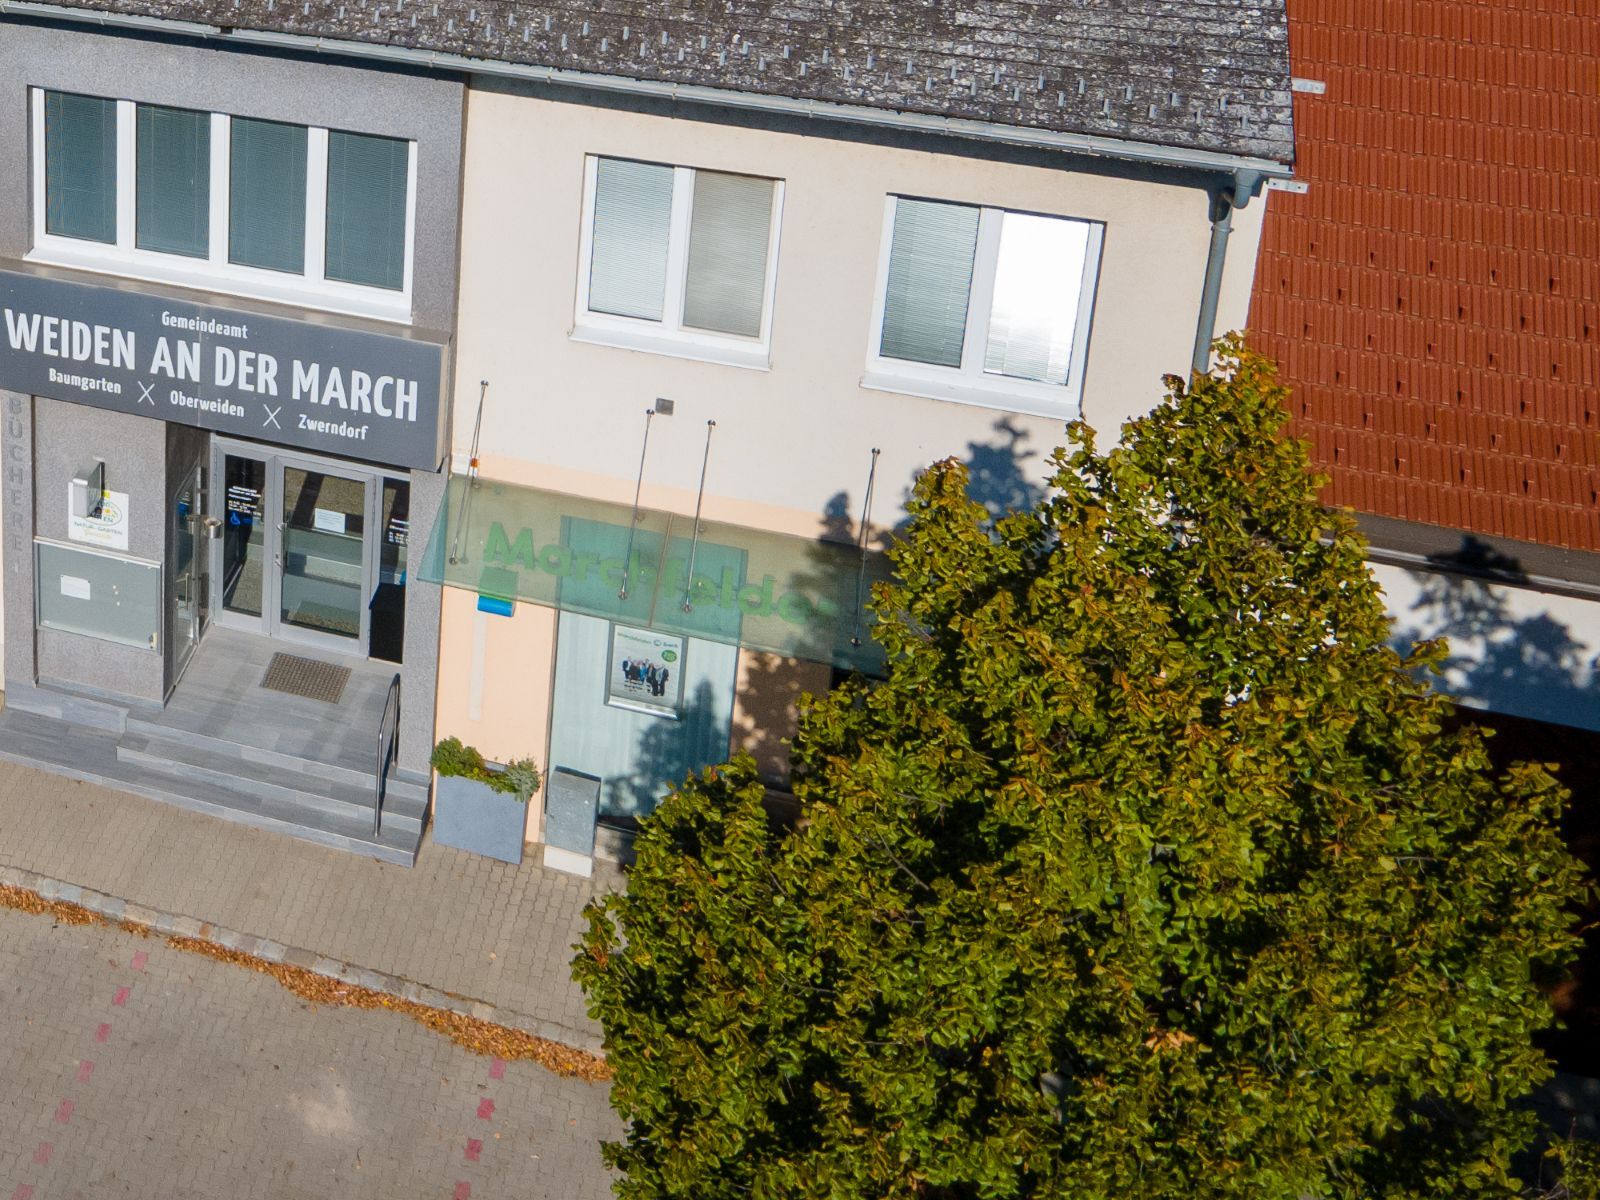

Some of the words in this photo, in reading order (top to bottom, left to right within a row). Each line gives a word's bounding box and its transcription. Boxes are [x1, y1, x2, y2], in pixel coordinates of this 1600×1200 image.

[4, 308, 136, 370] WEIDEN
[150, 336, 200, 383] AN
[215, 345, 278, 397] DER
[292, 359, 418, 422] MARCH
[161, 311, 248, 339] Gemeindeamt
[49, 367, 122, 395] Baumgarten
[170, 390, 245, 418] Oberweiden
[298, 413, 369, 441] Zwerndorf
[483, 521, 841, 625] Marchfelde
